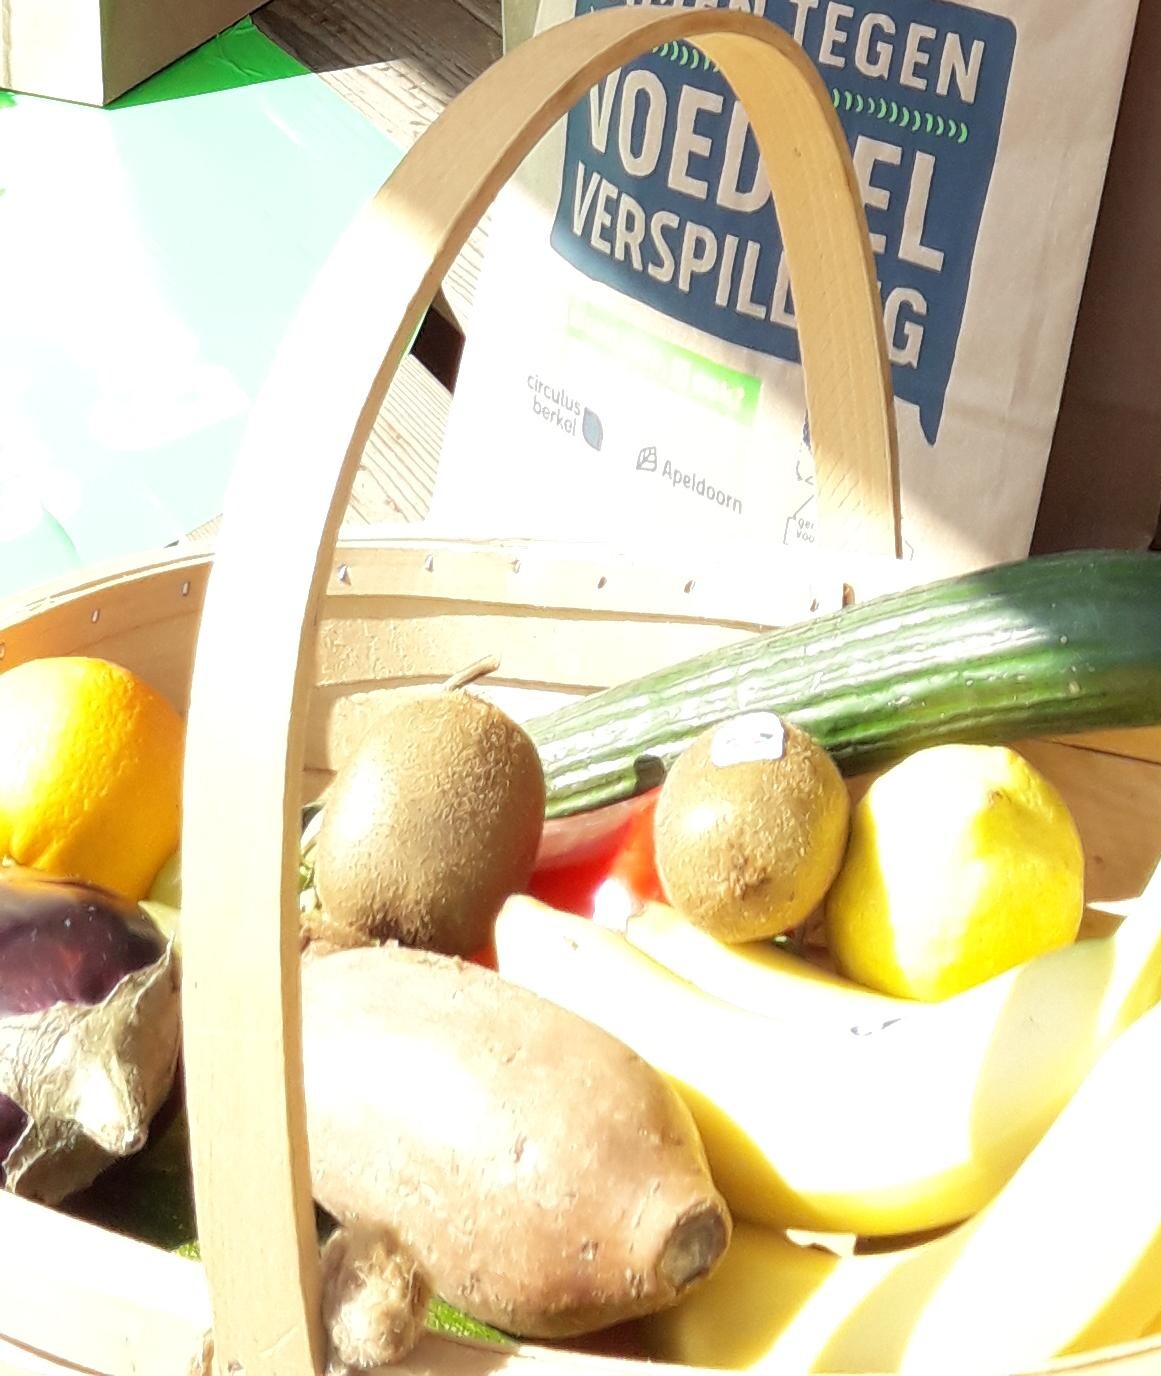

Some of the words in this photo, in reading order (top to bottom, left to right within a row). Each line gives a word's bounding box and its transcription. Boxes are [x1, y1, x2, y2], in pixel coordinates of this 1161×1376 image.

[589, 67, 944, 271] VOEDEL
[572, 160, 927, 369] VERSPILLG
[527, 374, 581, 416] circulus
[532, 395, 577, 437] berkel
[662, 460, 743, 515] Apeldoorn
